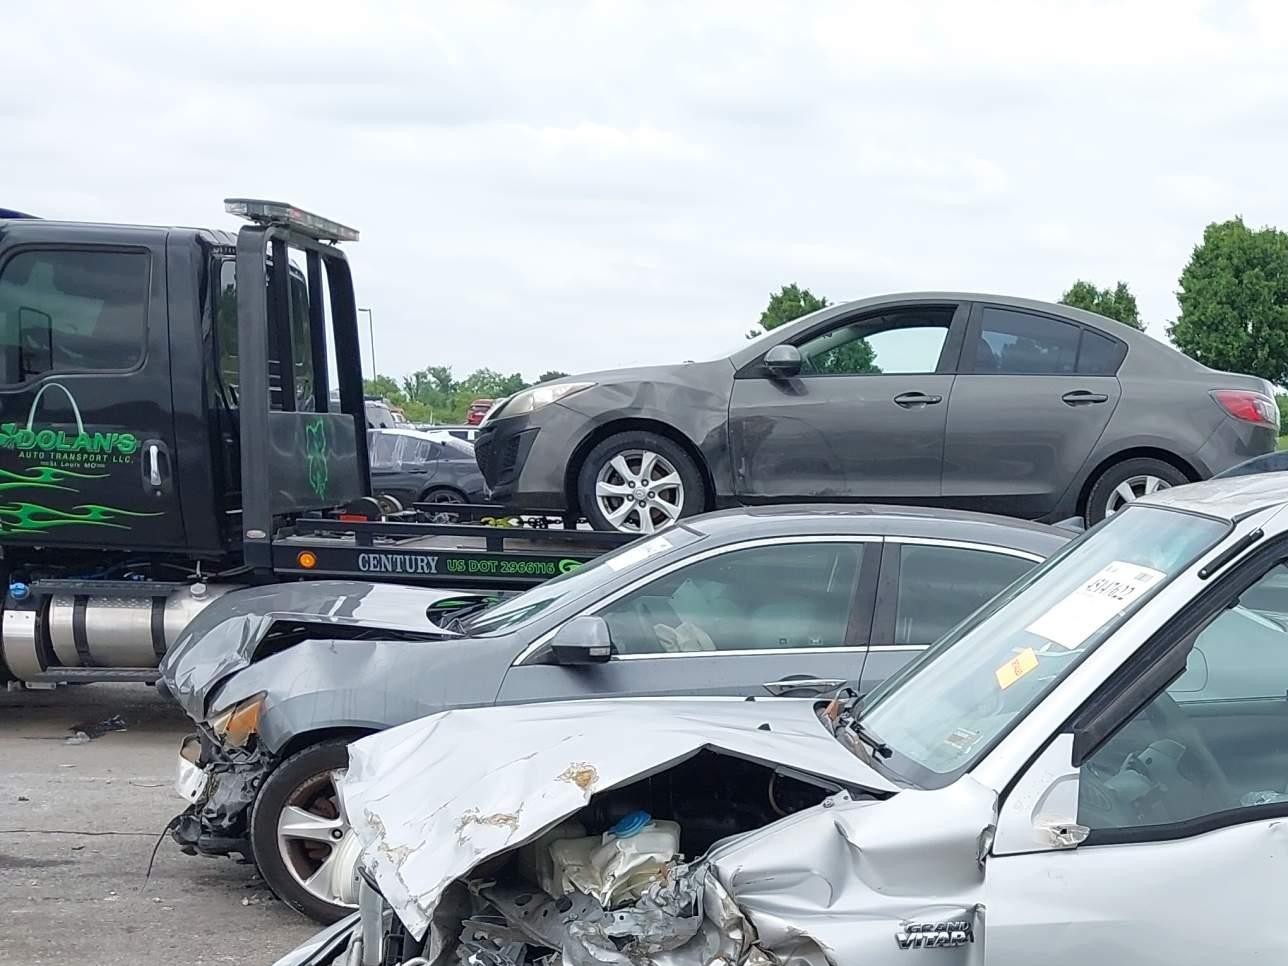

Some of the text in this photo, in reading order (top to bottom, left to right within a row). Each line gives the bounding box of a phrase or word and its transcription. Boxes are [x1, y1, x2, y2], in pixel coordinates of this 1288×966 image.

[15, 429, 137, 455] DOLAN'S
[18, 451, 134, 464] AUTO TRANSPORT LLC.
[358, 553, 439, 573] CENTURY
[447, 560, 556, 575] US DOT 2966116
[906, 921, 973, 932] GRAND
[896, 930, 975, 950] VITARA
